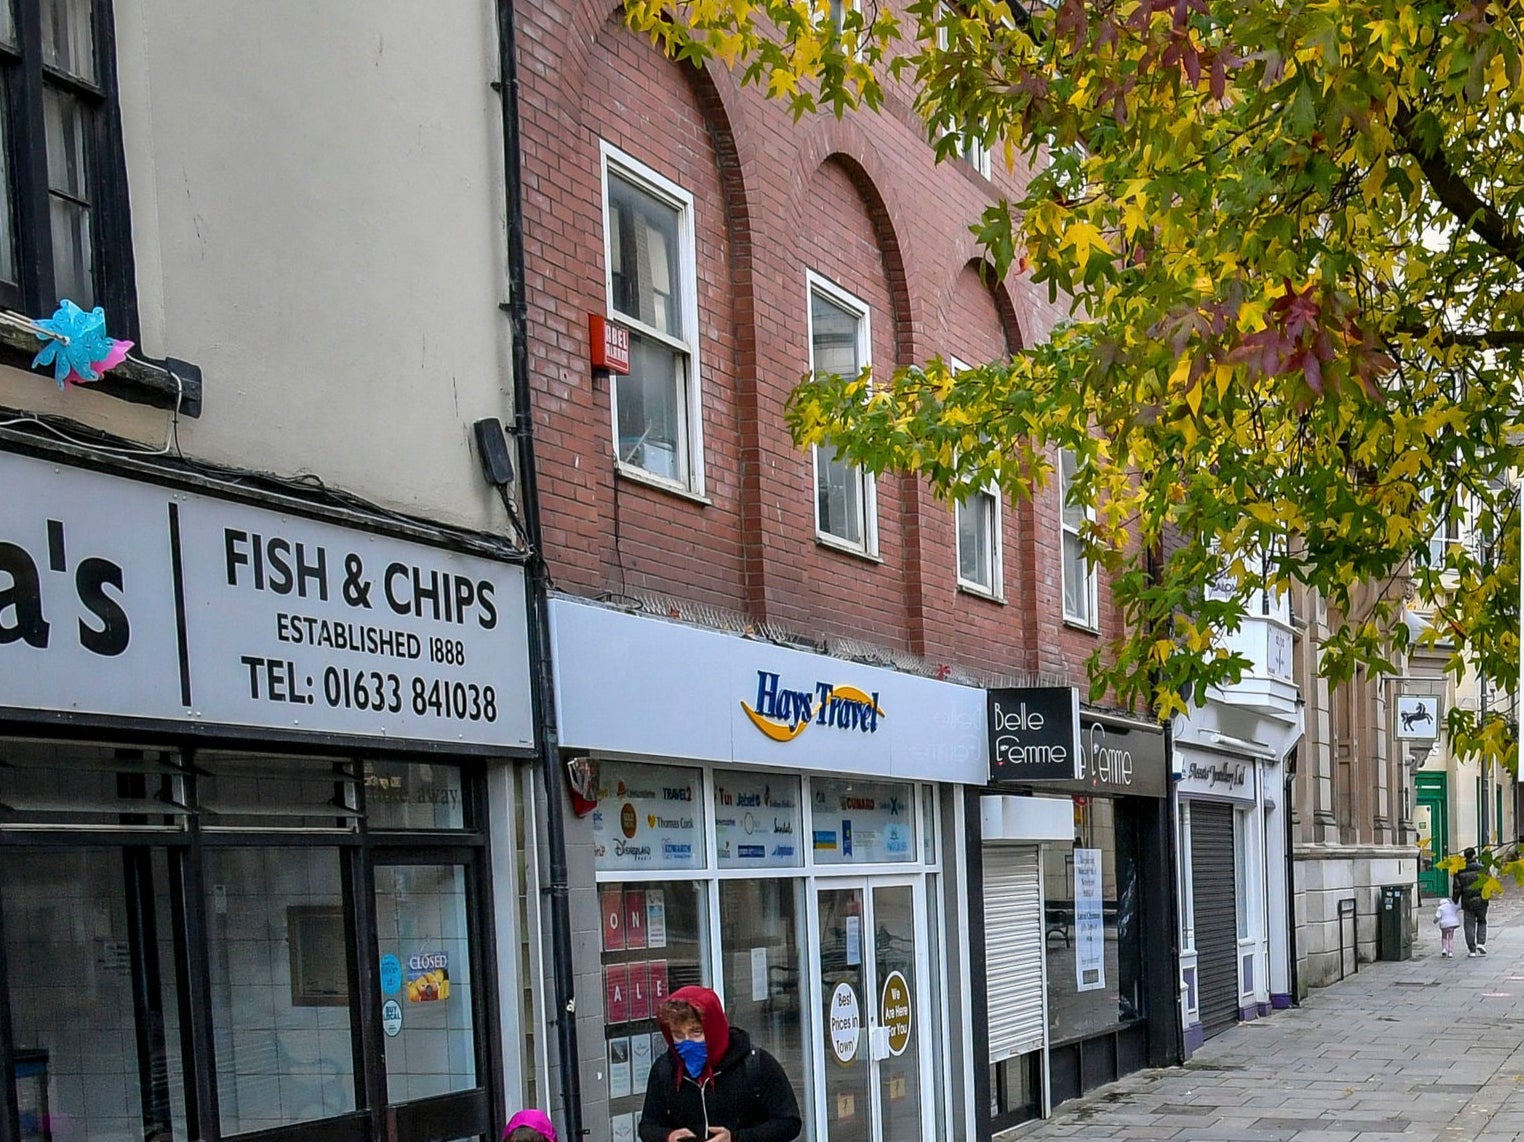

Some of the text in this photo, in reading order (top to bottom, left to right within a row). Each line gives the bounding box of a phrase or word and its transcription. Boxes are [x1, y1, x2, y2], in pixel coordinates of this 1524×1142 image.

[224, 528, 497, 629] FISH & CHIPS
[277, 613, 465, 665] ESTABLISHED 1888
[241, 656, 497, 722] TEL: 01633 841038
[755, 670, 879, 733] Hays Travel
[994, 702, 1044, 731] Belle
[996, 735, 1066, 764] Femme
[1089, 722, 1133, 785] Femme
[416, 787, 458, 811] away
[657, 816, 694, 829] Thomas Cook
[409, 955, 447, 970] CLOSED
[891, 988, 900, 1000] We
[832, 1016, 858, 1030] Prices in
[885, 1005, 908, 1020] Are Here
[897, 1022, 908, 1034] You
